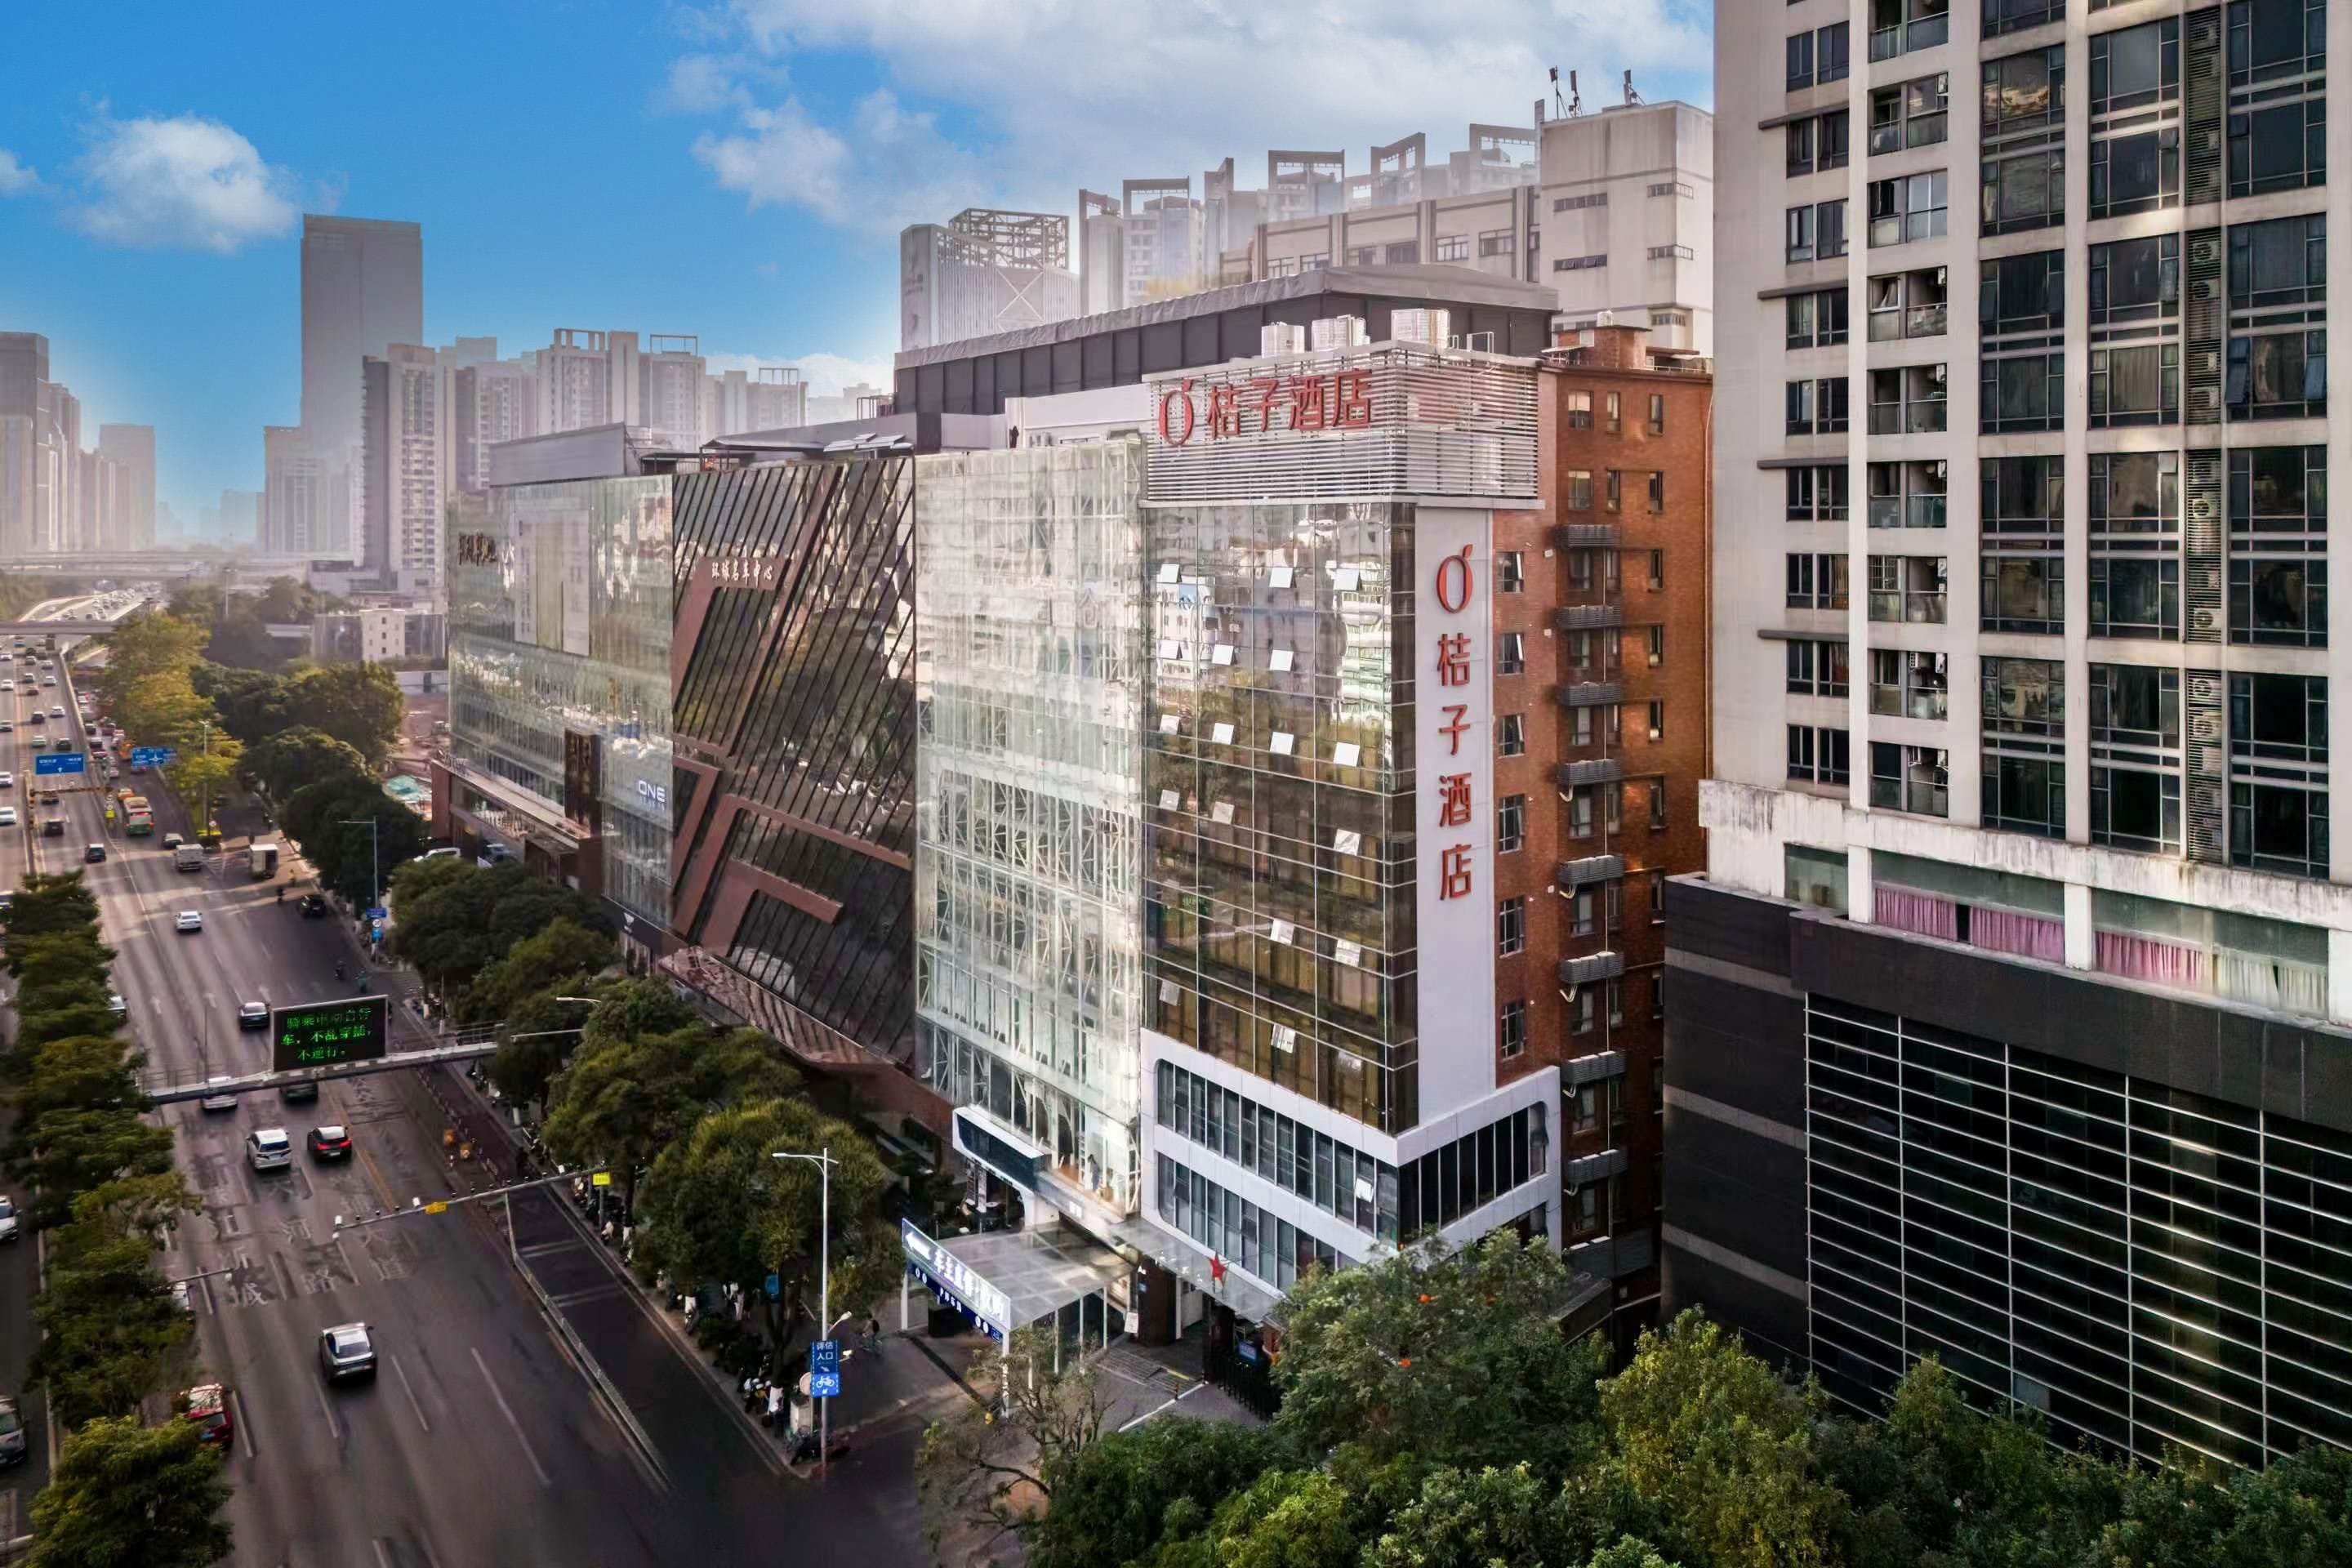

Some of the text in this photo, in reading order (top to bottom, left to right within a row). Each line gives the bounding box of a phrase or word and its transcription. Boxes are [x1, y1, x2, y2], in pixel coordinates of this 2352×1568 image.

[1207, 368, 1373, 439] 桔子酒店
[1437, 632, 1472, 901] 桔子酒店
[638, 780, 666, 803] ONE
[817, 1352, 834, 1361] 入口
